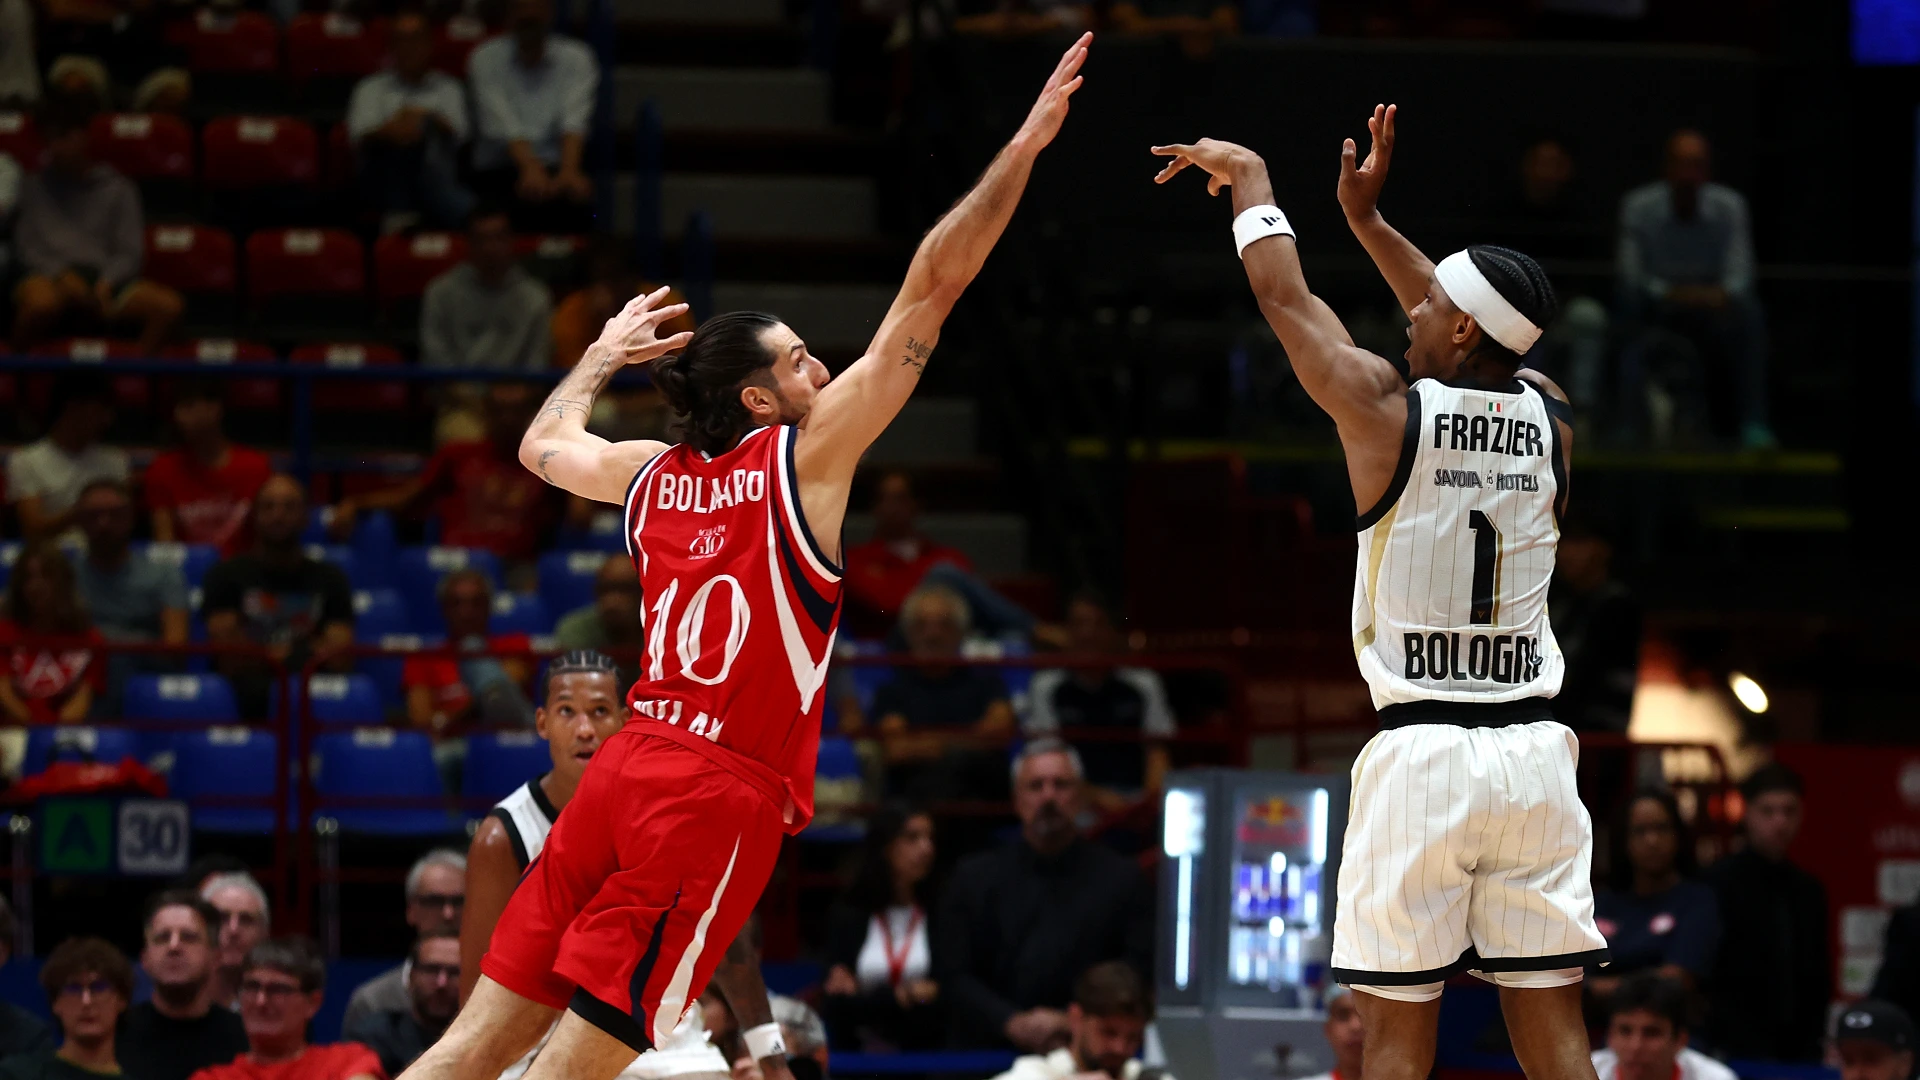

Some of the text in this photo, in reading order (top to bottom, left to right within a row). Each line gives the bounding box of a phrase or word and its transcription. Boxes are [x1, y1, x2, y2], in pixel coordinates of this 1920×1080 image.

[1434, 413, 1544, 457] FRAZIER
[1433, 468, 1483, 489] SAVOIA
[1495, 472, 1539, 493] HOTELS
[1469, 509, 1503, 628] 1
[648, 574, 751, 685] 10
[57, 812, 181, 861] A 30
